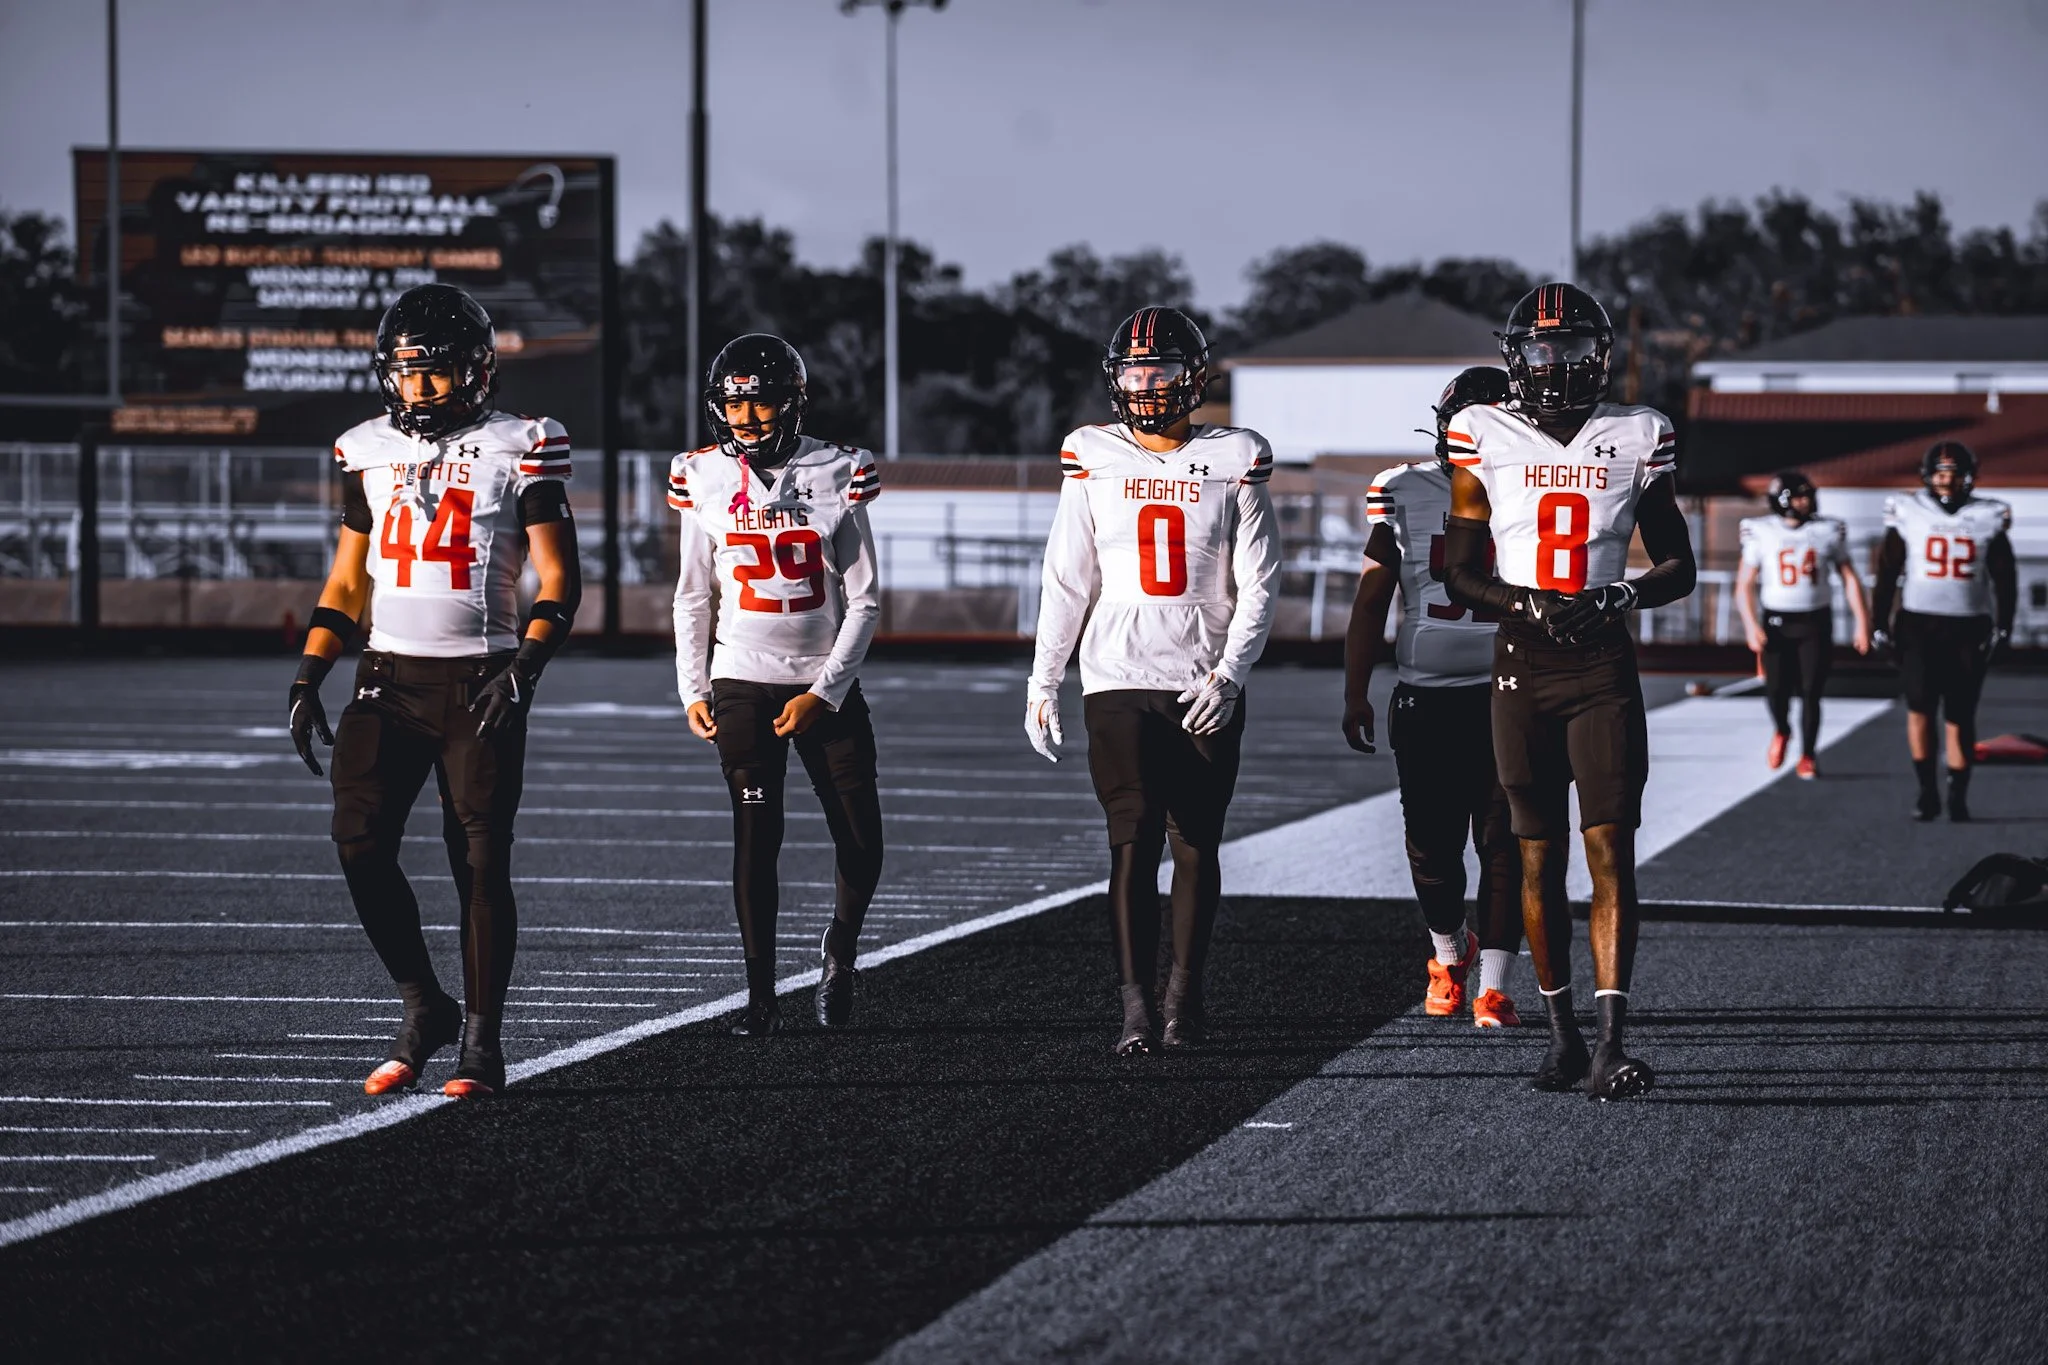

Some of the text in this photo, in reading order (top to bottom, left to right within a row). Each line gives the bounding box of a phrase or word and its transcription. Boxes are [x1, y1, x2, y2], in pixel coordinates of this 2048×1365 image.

[235, 172, 371, 193] KILLEEN
[175, 191, 497, 216] VARSITY FOOTBALL
[206, 214, 467, 235] RE-BROADCAST
[247, 267, 370, 287] WEDNESDAY
[390, 461, 470, 484] HGHTS
[1525, 465, 1608, 490] HEIGHTS
[1125, 479, 1200, 502] HEIGHTS
[735, 508, 809, 531] HEIGHTS
[381, 484, 477, 589] 44
[1536, 492, 1590, 595] 8
[1138, 504, 1187, 596] 0
[1926, 536, 1976, 579] 92
[726, 529, 826, 613] 29
[1778, 548, 1818, 586] 64
